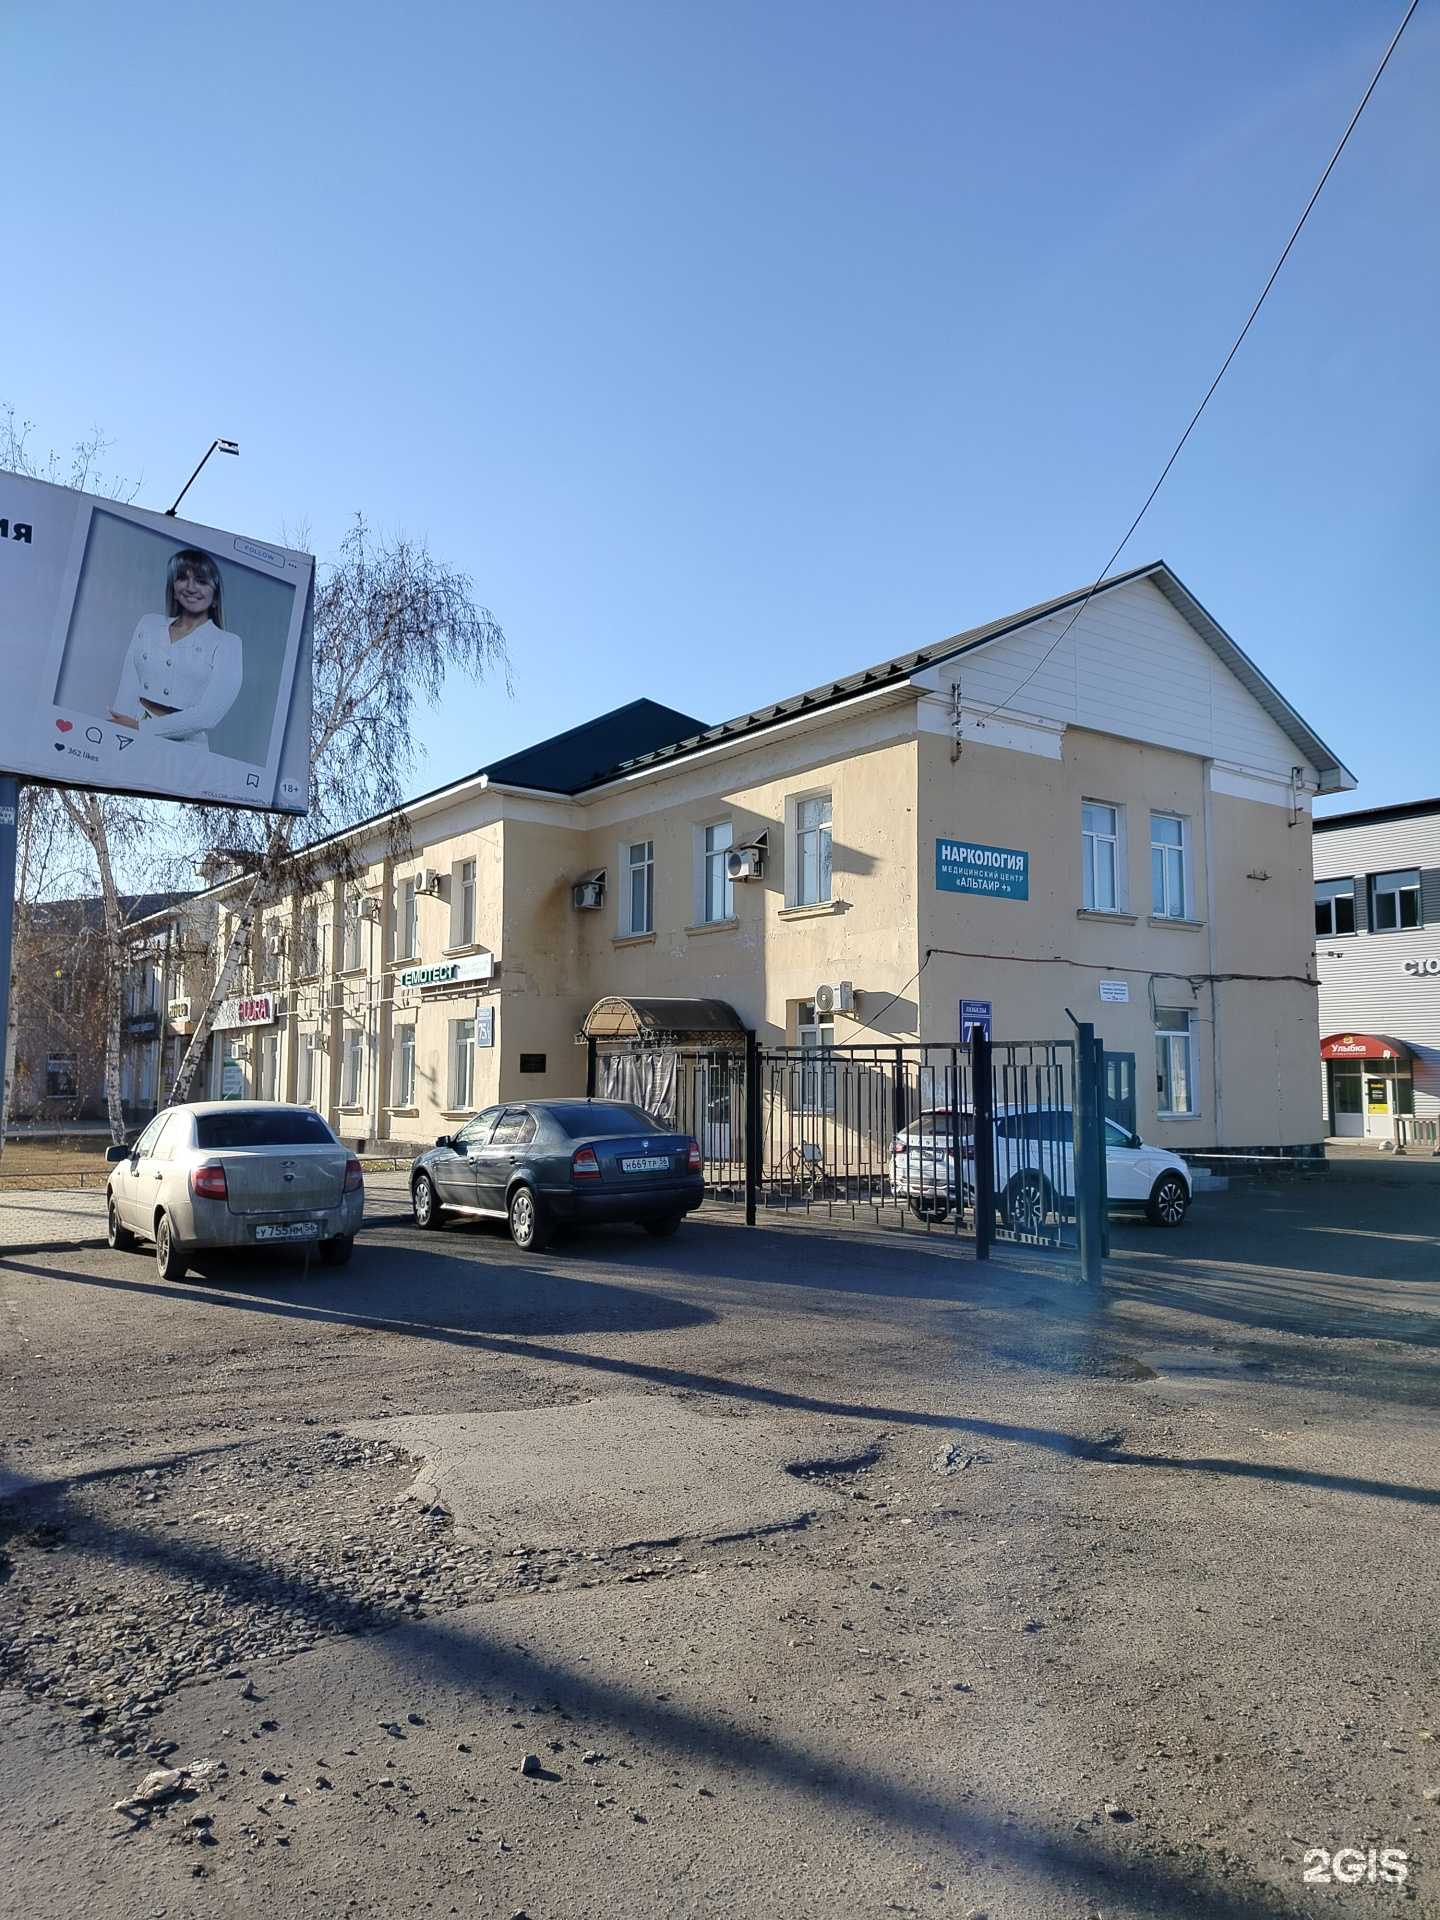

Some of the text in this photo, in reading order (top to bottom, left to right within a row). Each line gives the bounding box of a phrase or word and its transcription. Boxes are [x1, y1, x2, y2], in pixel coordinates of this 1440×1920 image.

[83, 751, 99, 762] likes
[283, 783, 298, 793] 18+
[942, 845, 1024, 871] НАРКОЛОГИЯ
[942, 865, 1024, 883] МЕДИЦИНСКИЙ ЦЕНТР
[956, 877, 1000, 892] «АЛЬТАИР
[1331, 1043, 1367, 1052] Улыбка
